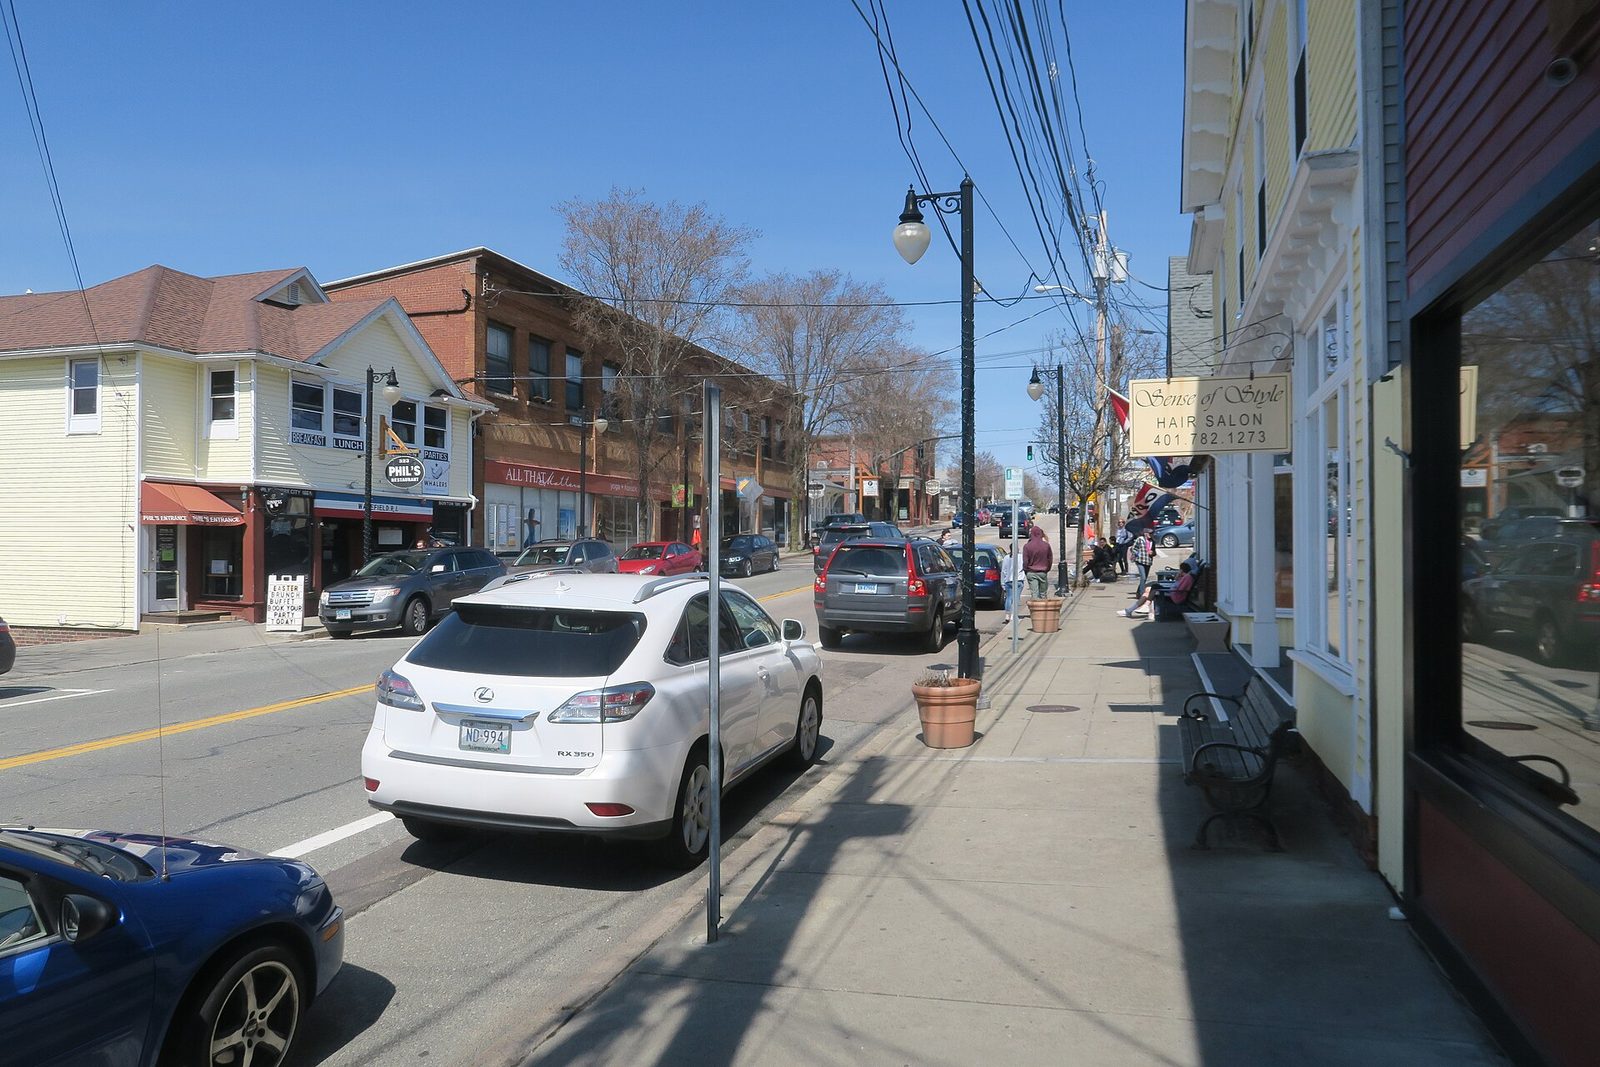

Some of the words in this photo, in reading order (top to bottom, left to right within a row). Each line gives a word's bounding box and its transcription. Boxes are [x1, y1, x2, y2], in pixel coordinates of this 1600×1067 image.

[1135, 388, 1197, 407] Sense
[1201, 387, 1223, 411] of
[1225, 384, 1284, 409] Style
[1156, 416, 1197, 429] HAIR
[1205, 413, 1263, 427] SALON
[292, 432, 325, 446] BREAKFAST
[1153, 430, 1267, 446] 401.782.1273
[333, 439, 363, 450] LUNCH
[424, 451, 448, 461] PARTIES
[388, 465, 421, 477] PHIL'S
[505, 468, 523, 482] ALL
[523, 470, 546, 484] THAT
[210, 516, 241, 524] ENTRANCE
[271, 591, 300, 599] BRUNCH
[274, 611, 295, 619] PARTY
[557, 750, 573, 758] RX
[574, 751, 595, 759] 350
